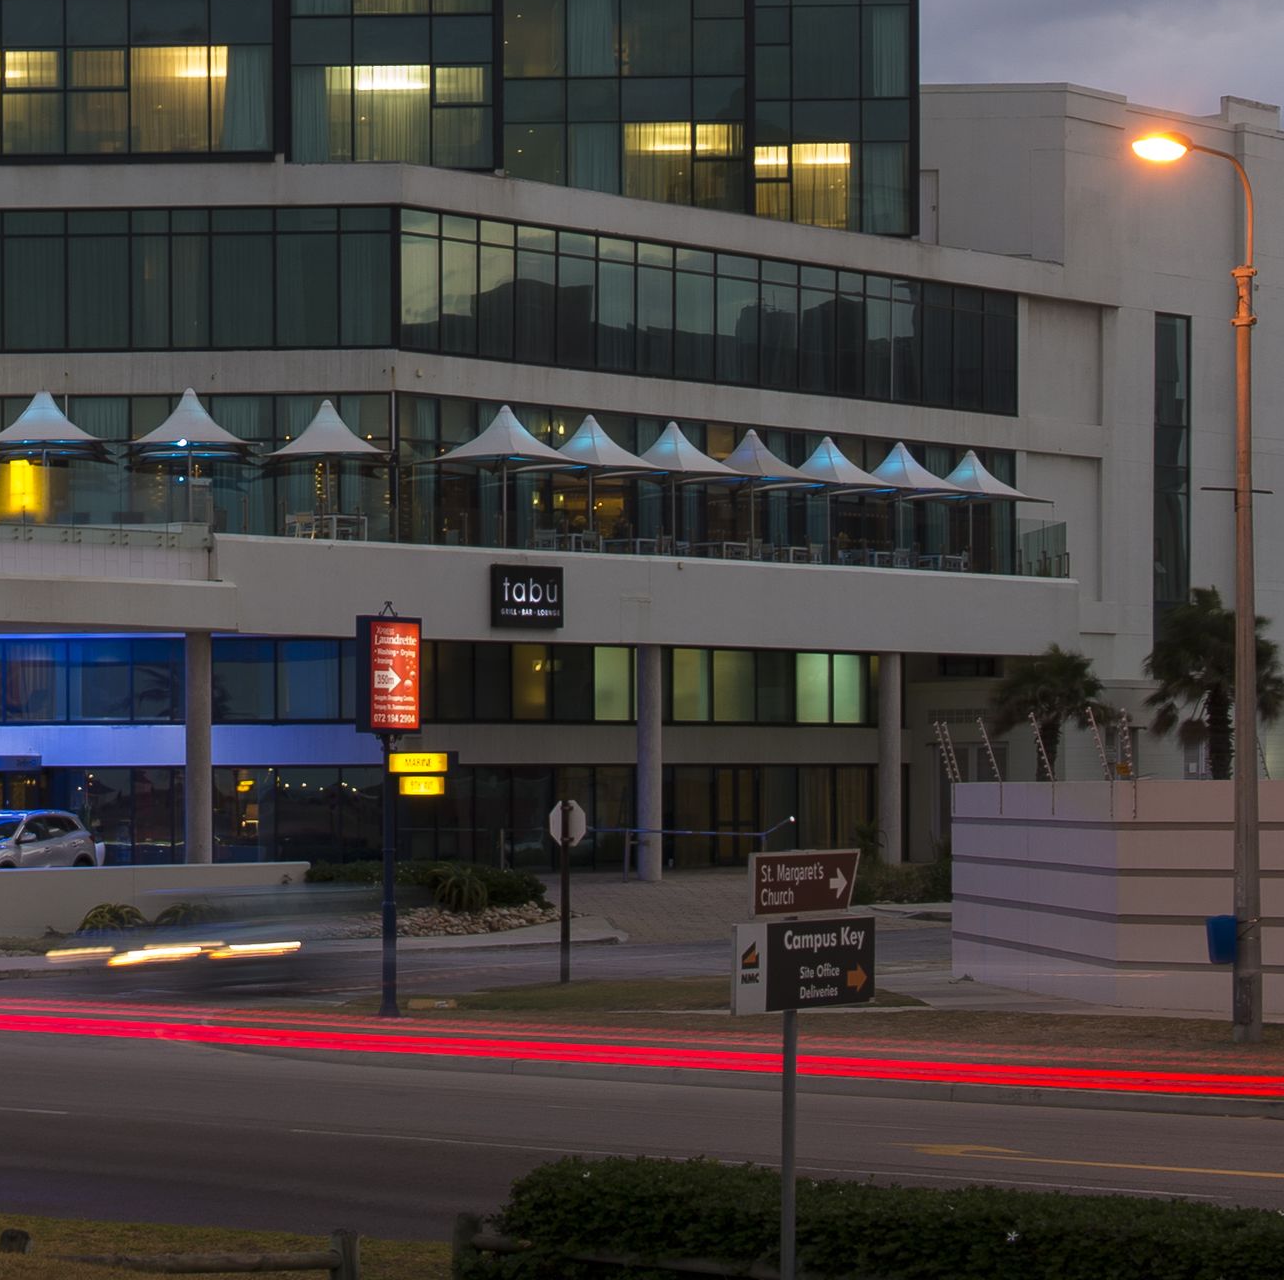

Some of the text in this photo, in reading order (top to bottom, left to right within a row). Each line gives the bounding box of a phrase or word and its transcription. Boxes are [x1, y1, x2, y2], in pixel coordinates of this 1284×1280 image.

[521, 608, 533, 616] BAR
[374, 634, 417, 646] Laundrette
[401, 648, 416, 658] Drying
[377, 674, 394, 684] 350m
[374, 713, 386, 723] 072
[387, 714, 399, 723] 194
[761, 862, 824, 886] St. Margaret's
[761, 888, 794, 906] Church
[784, 926, 865, 953] Campus Key
[800, 962, 840, 980] Site Office
[741, 972, 760, 985] NMC
[800, 985, 838, 1000] Deliveries
